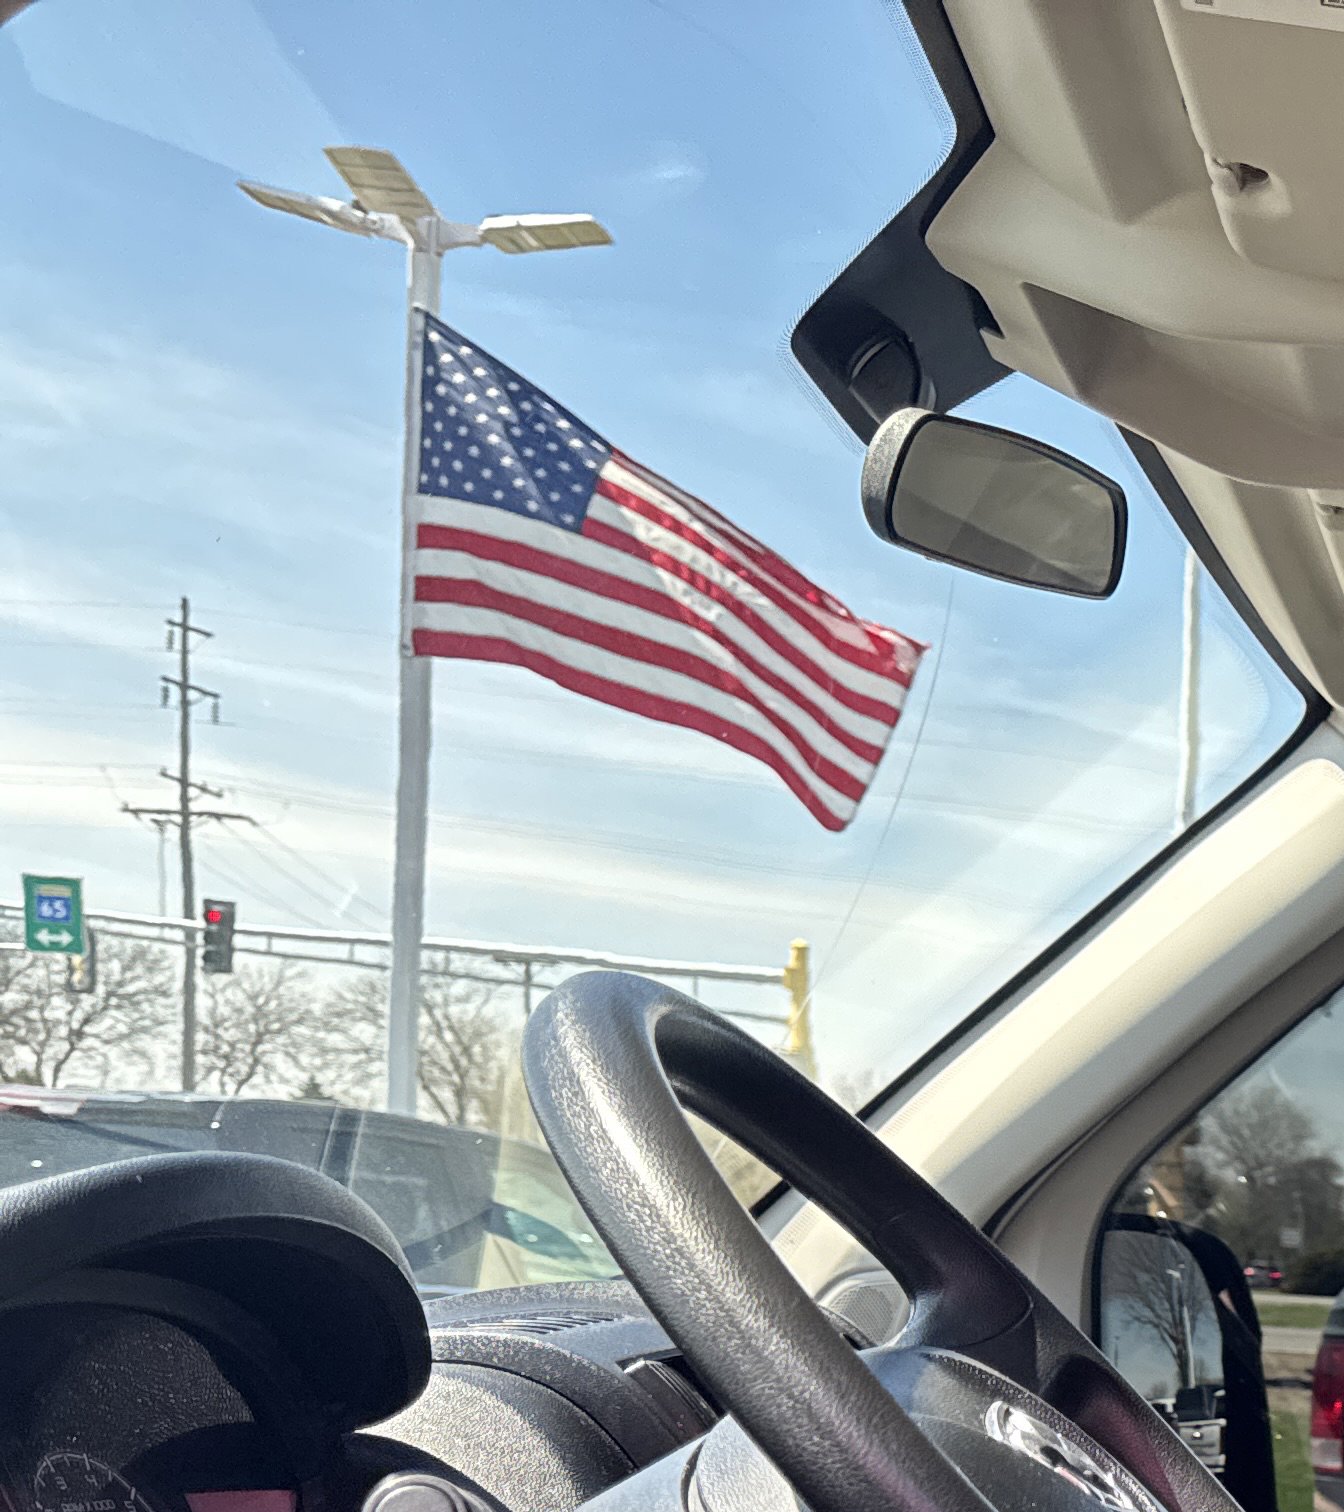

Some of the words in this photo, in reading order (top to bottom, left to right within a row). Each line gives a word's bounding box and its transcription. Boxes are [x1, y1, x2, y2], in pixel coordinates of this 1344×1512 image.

[40, 899, 67, 919] 65
[54, 1475, 68, 1490] 3
[84, 1473, 98, 1487] 4
